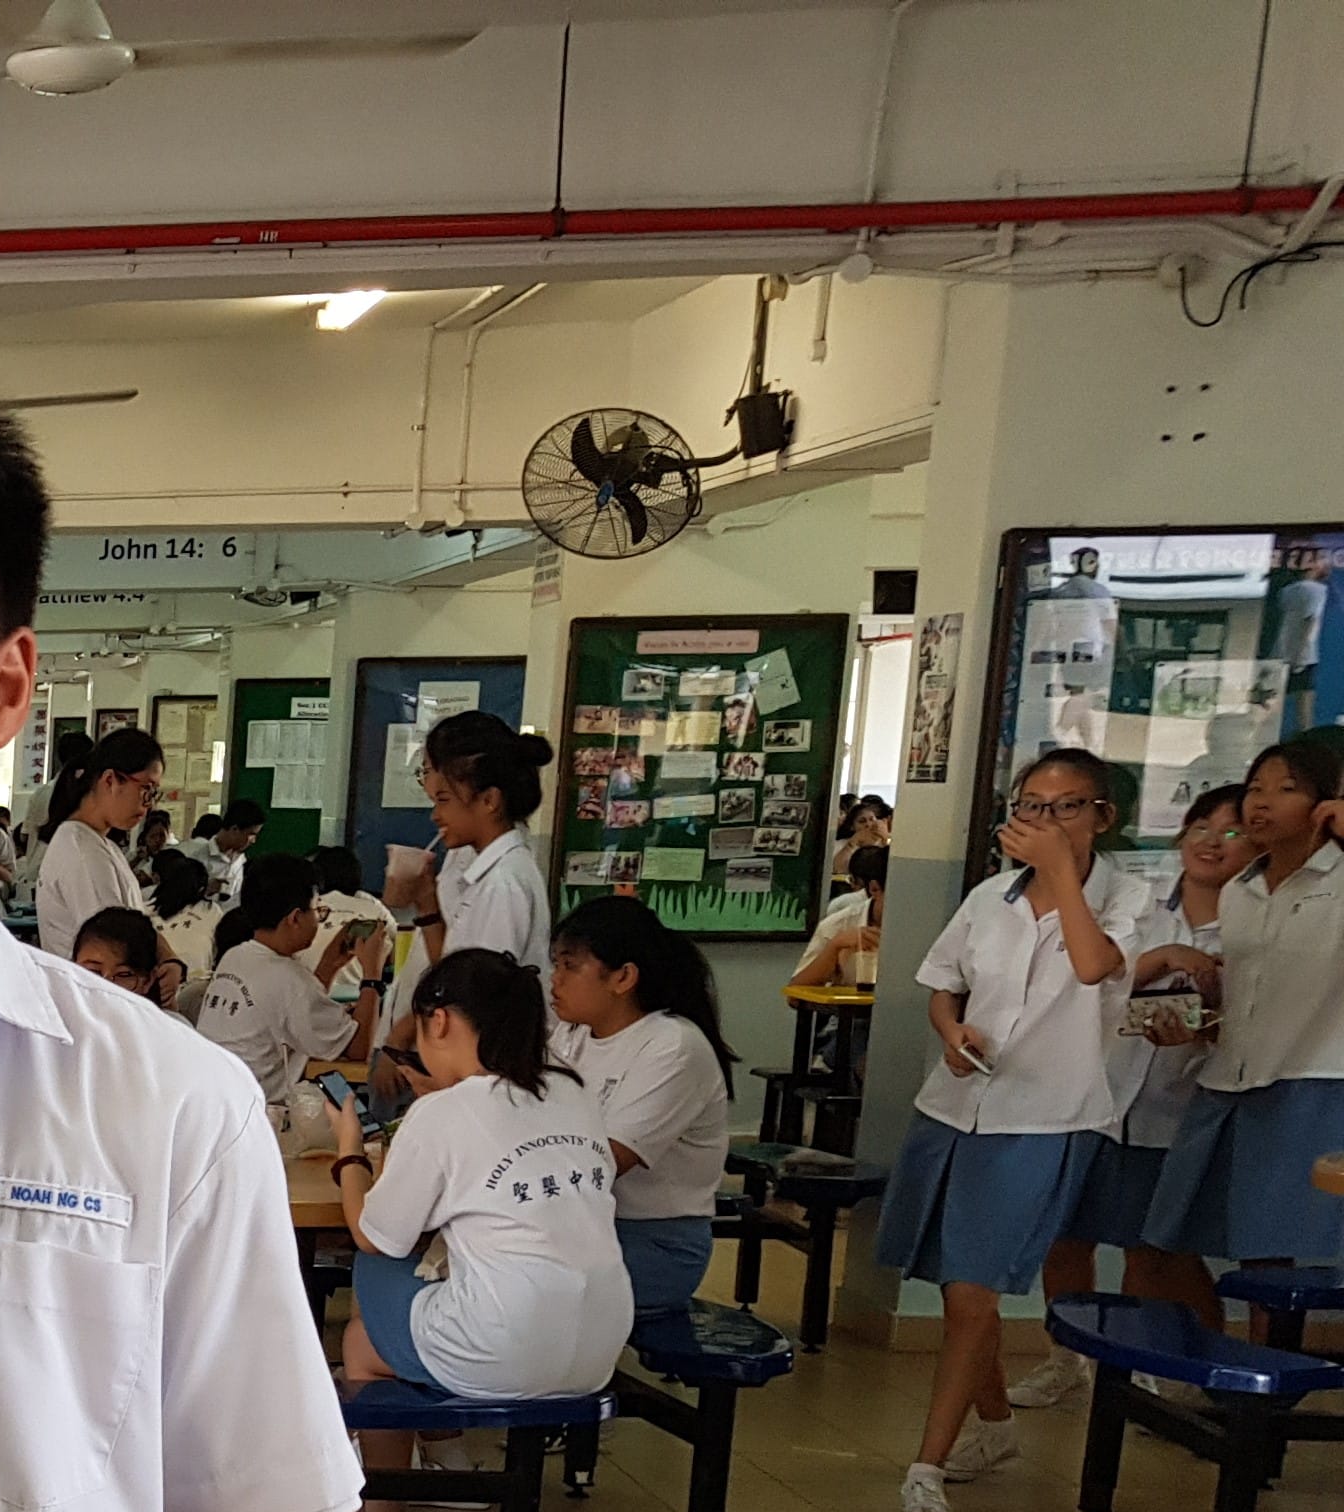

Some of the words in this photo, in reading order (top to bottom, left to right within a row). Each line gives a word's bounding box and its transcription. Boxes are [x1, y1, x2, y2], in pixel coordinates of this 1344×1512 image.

[98, 538, 158, 561] John
[165, 537, 204, 560] 14:
[222, 536, 238, 558] 6
[484, 1153, 515, 1191] HOLY
[10, 1185, 52, 1206] NOAH
[57, 1191, 79, 1209] NG
[83, 1196, 103, 1213] CS
